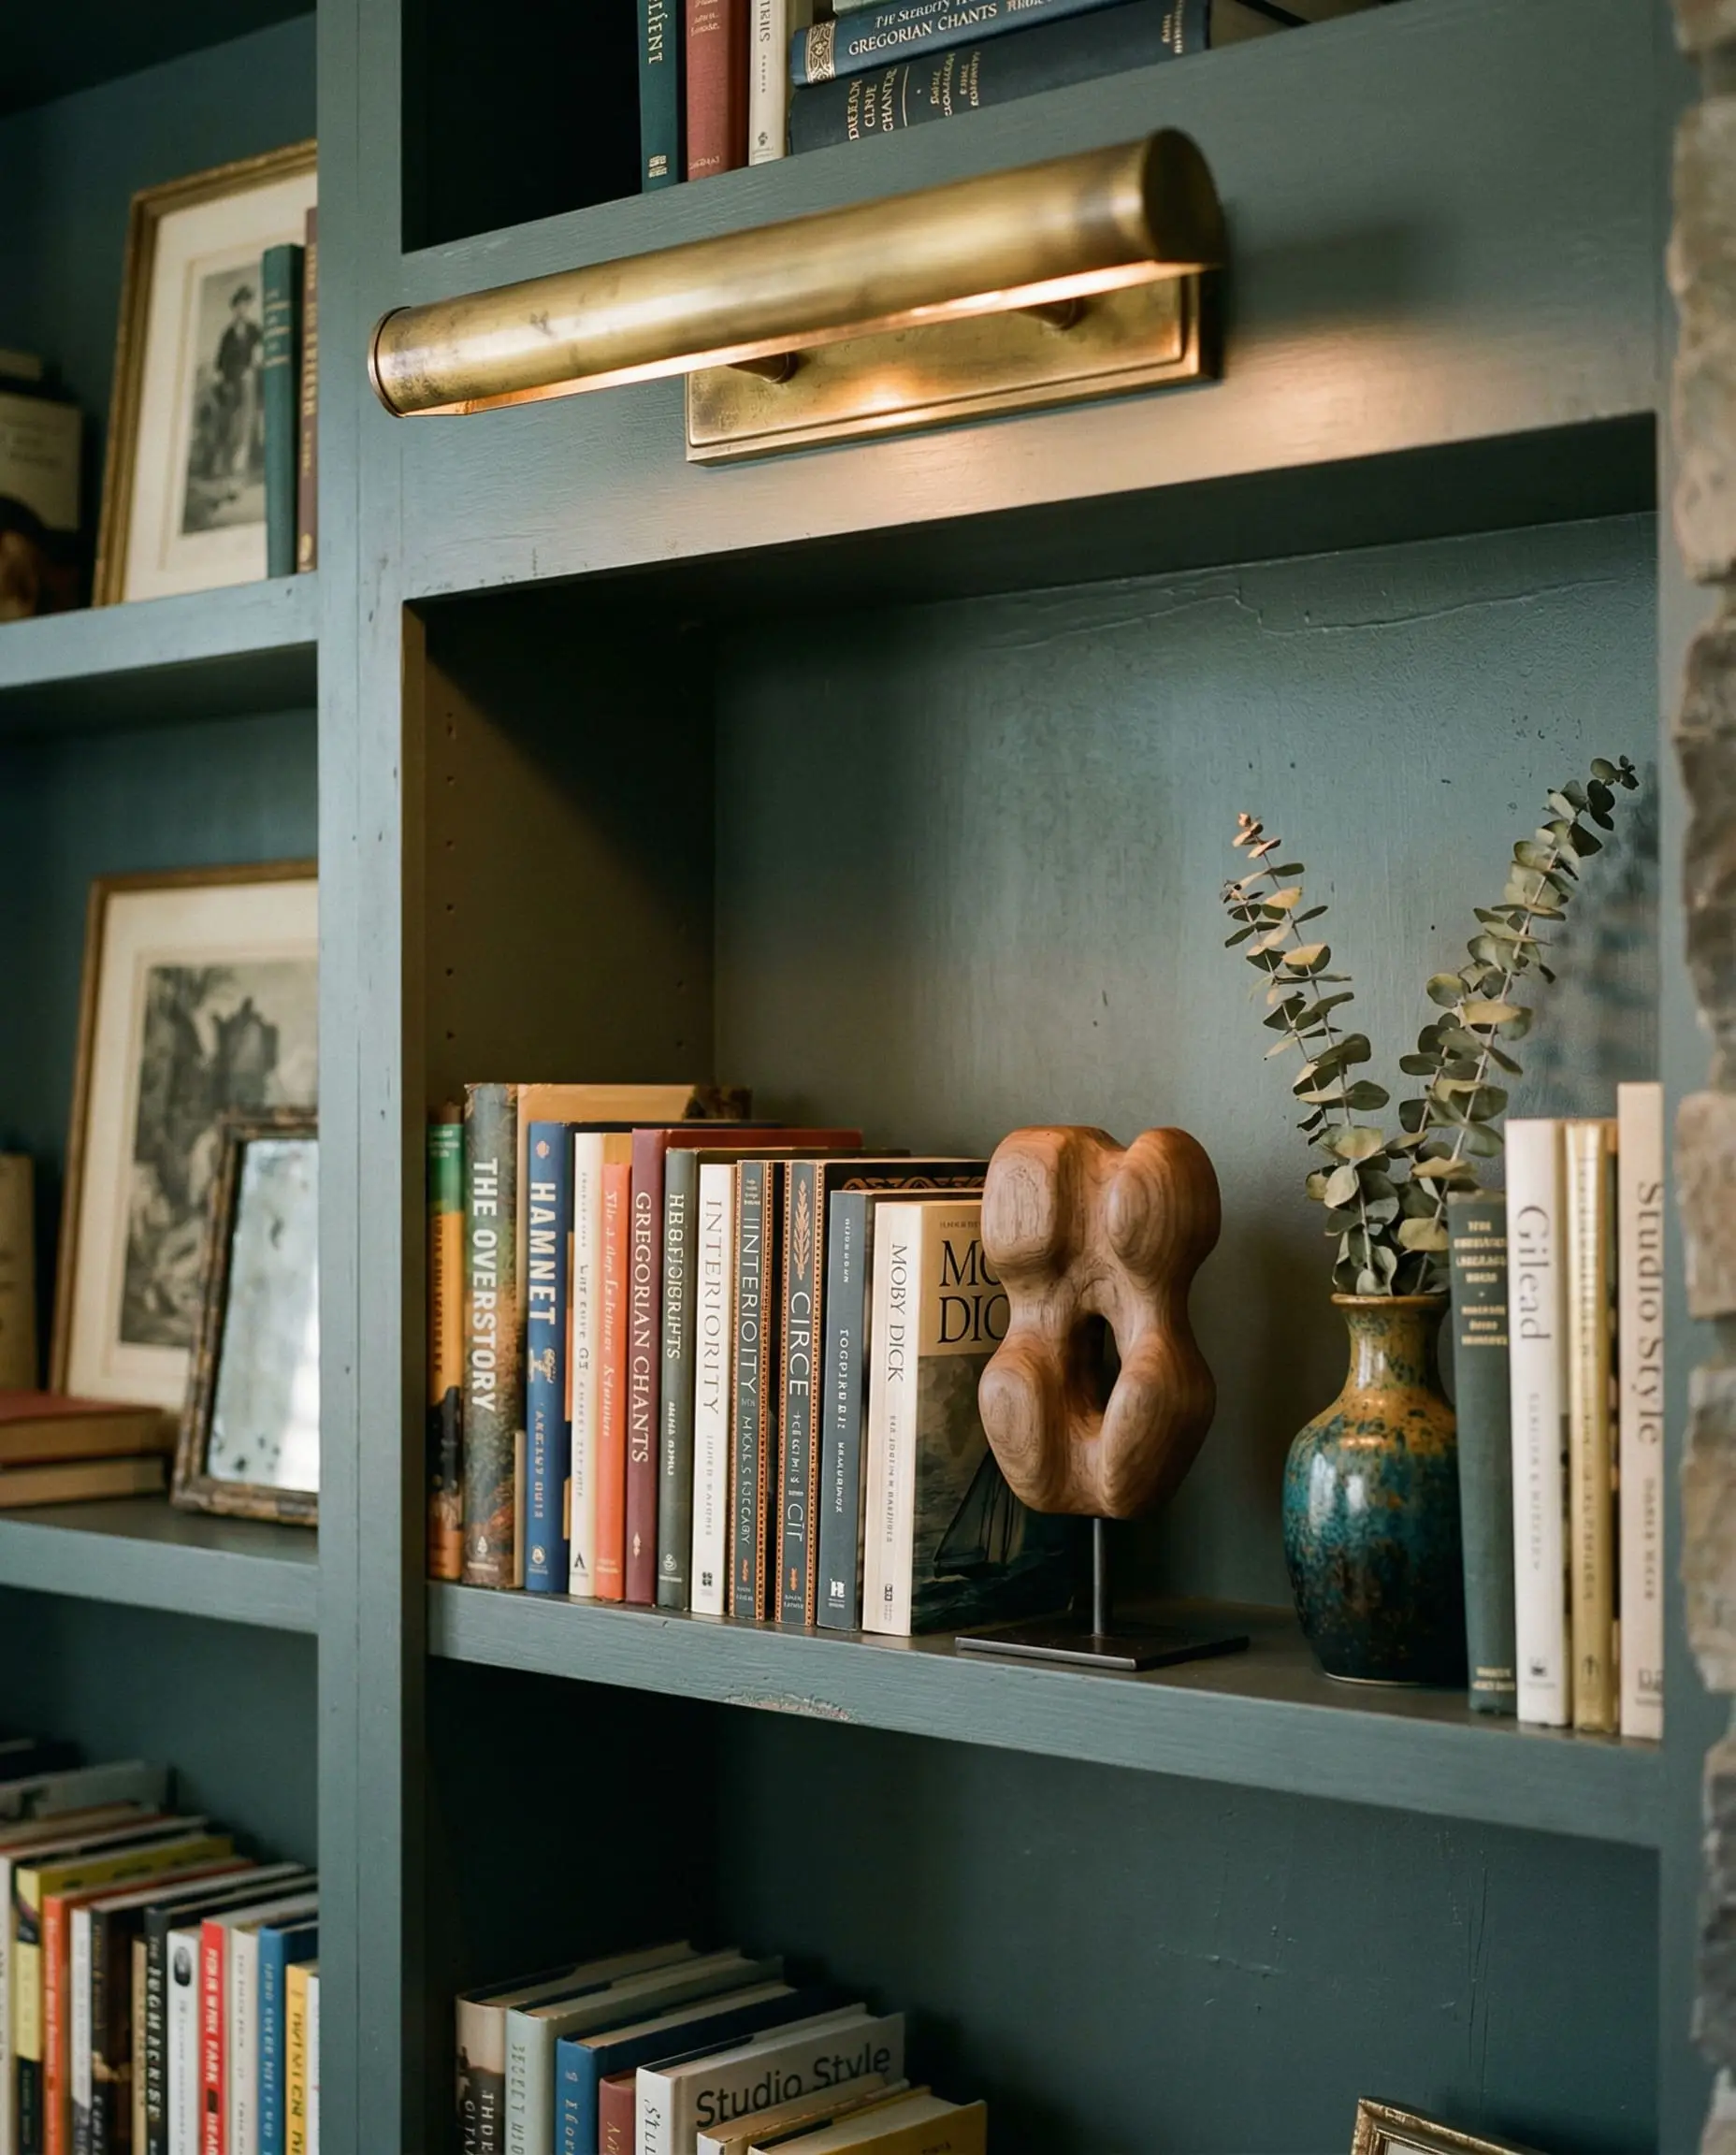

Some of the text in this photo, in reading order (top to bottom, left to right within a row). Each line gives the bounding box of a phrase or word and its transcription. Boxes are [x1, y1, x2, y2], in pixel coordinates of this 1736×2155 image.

[848, 21, 933, 56] GREGORIAN
[937, 4, 998, 31] CHANTS
[471, 1158, 499, 1412] THE OVERSTORY
[529, 1181, 556, 1325] HAMNET
[703, 1200, 723, 1414] INTERIORITY
[888, 1244, 908, 1381] MOBY DICK
[1517, 1205, 1554, 1340] Gilead
[1637, 1182, 1663, 1323] Studio
[631, 1192, 652, 1463] GREGORIAN CHANTS
[789, 1291, 811, 1396] CIRCE
[1631, 1338, 1663, 1445] Style
[696, 2069, 803, 2128] Studio
